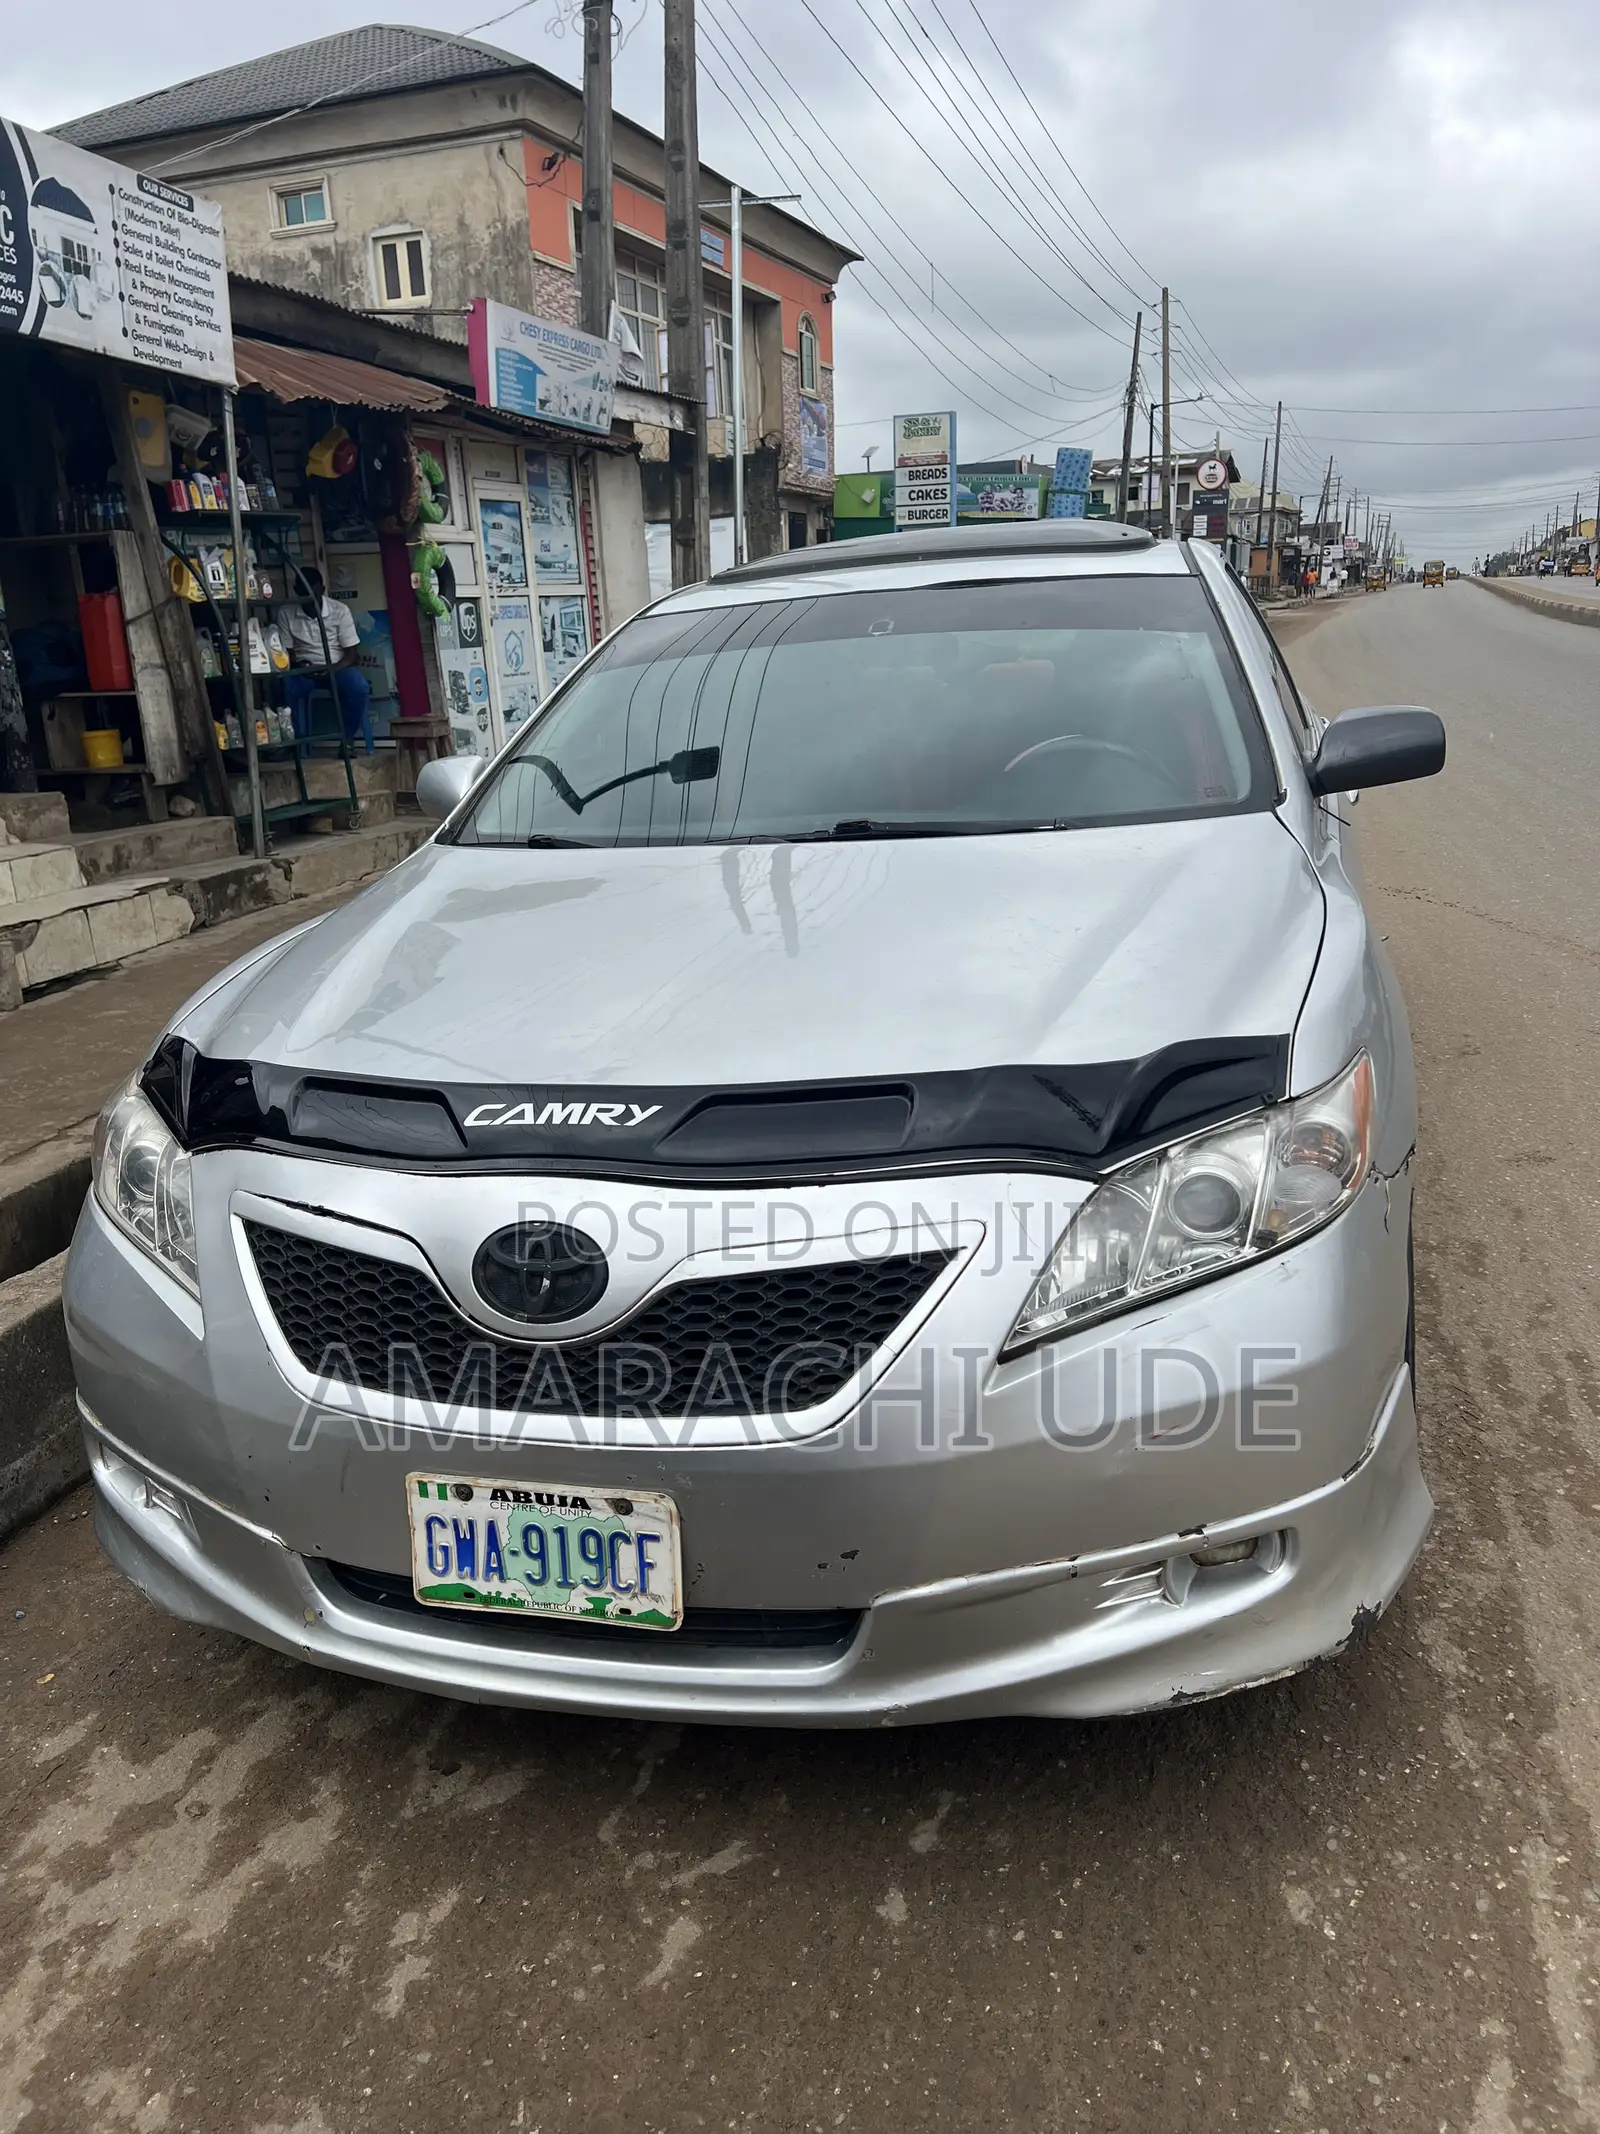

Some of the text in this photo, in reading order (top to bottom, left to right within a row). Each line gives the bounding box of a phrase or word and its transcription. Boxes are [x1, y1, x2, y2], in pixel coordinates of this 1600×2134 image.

[143, 180, 189, 207] OUR SERVICES
[119, 188, 220, 238] Construction Of Bio-Digester
[124, 207, 180, 240] (Modern Toilet)
[121, 224, 222, 270] General Building Contractor
[122, 241, 211, 282] Sales of Toilet Chemicals
[124, 259, 214, 300] Real Estate Management
[132, 278, 214, 318] & Property Consultancy
[128, 294, 222, 333] General Cleaning Services
[135, 313, 184, 338] & Fumigation
[132, 328, 214, 362] General Web-Design &
[542, 328, 570, 349] EXPRESS
[570, 338, 590, 356] CARGO
[132, 346, 182, 369] Development
[903, 425, 942, 440] BAKERY
[908, 468, 948, 481] BREADS
[908, 488, 948, 502] CAKES
[908, 508, 948, 520] BURGER
[463, 1102, 664, 1127] CAMRY
[490, 1488, 592, 1510] ABUJA
[490, 1501, 592, 1518] CENTRE OF UNITY
[425, 1512, 662, 1594] GWA-919CF
[480, 1596, 518, 1606] FEDERAL
[521, 1600, 563, 1610] REPUBLIC
[580, 1607, 616, 1618] NIGERIA
